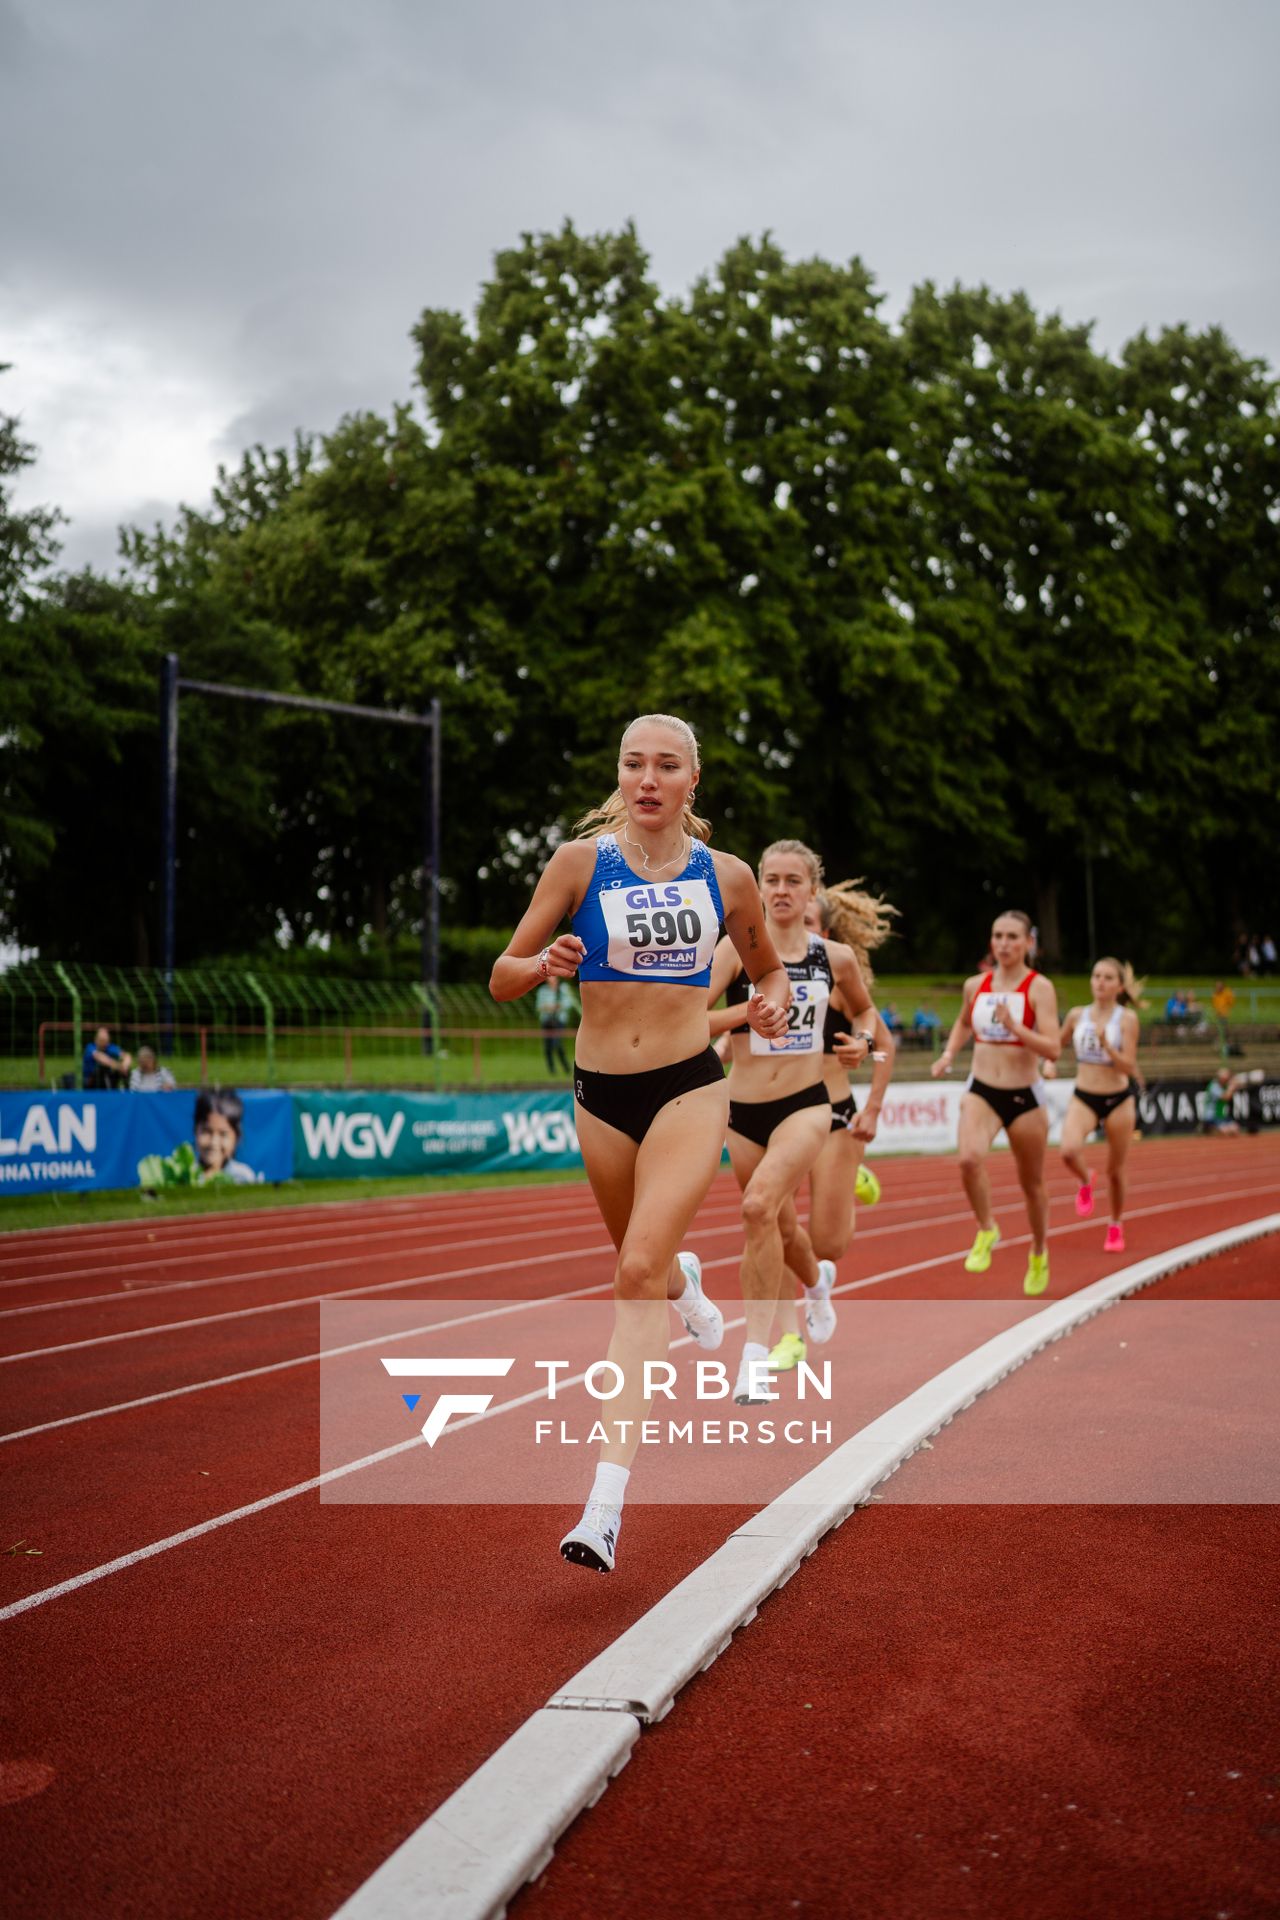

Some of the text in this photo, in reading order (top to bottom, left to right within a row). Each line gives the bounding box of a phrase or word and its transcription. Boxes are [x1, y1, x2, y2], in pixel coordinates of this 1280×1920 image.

[626, 909, 702, 948] 590
[660, 952, 694, 963] PLAN
[787, 1004, 816, 1030] 24
[881, 1097, 947, 1129] orest
[300, 1111, 405, 1160] WGV
